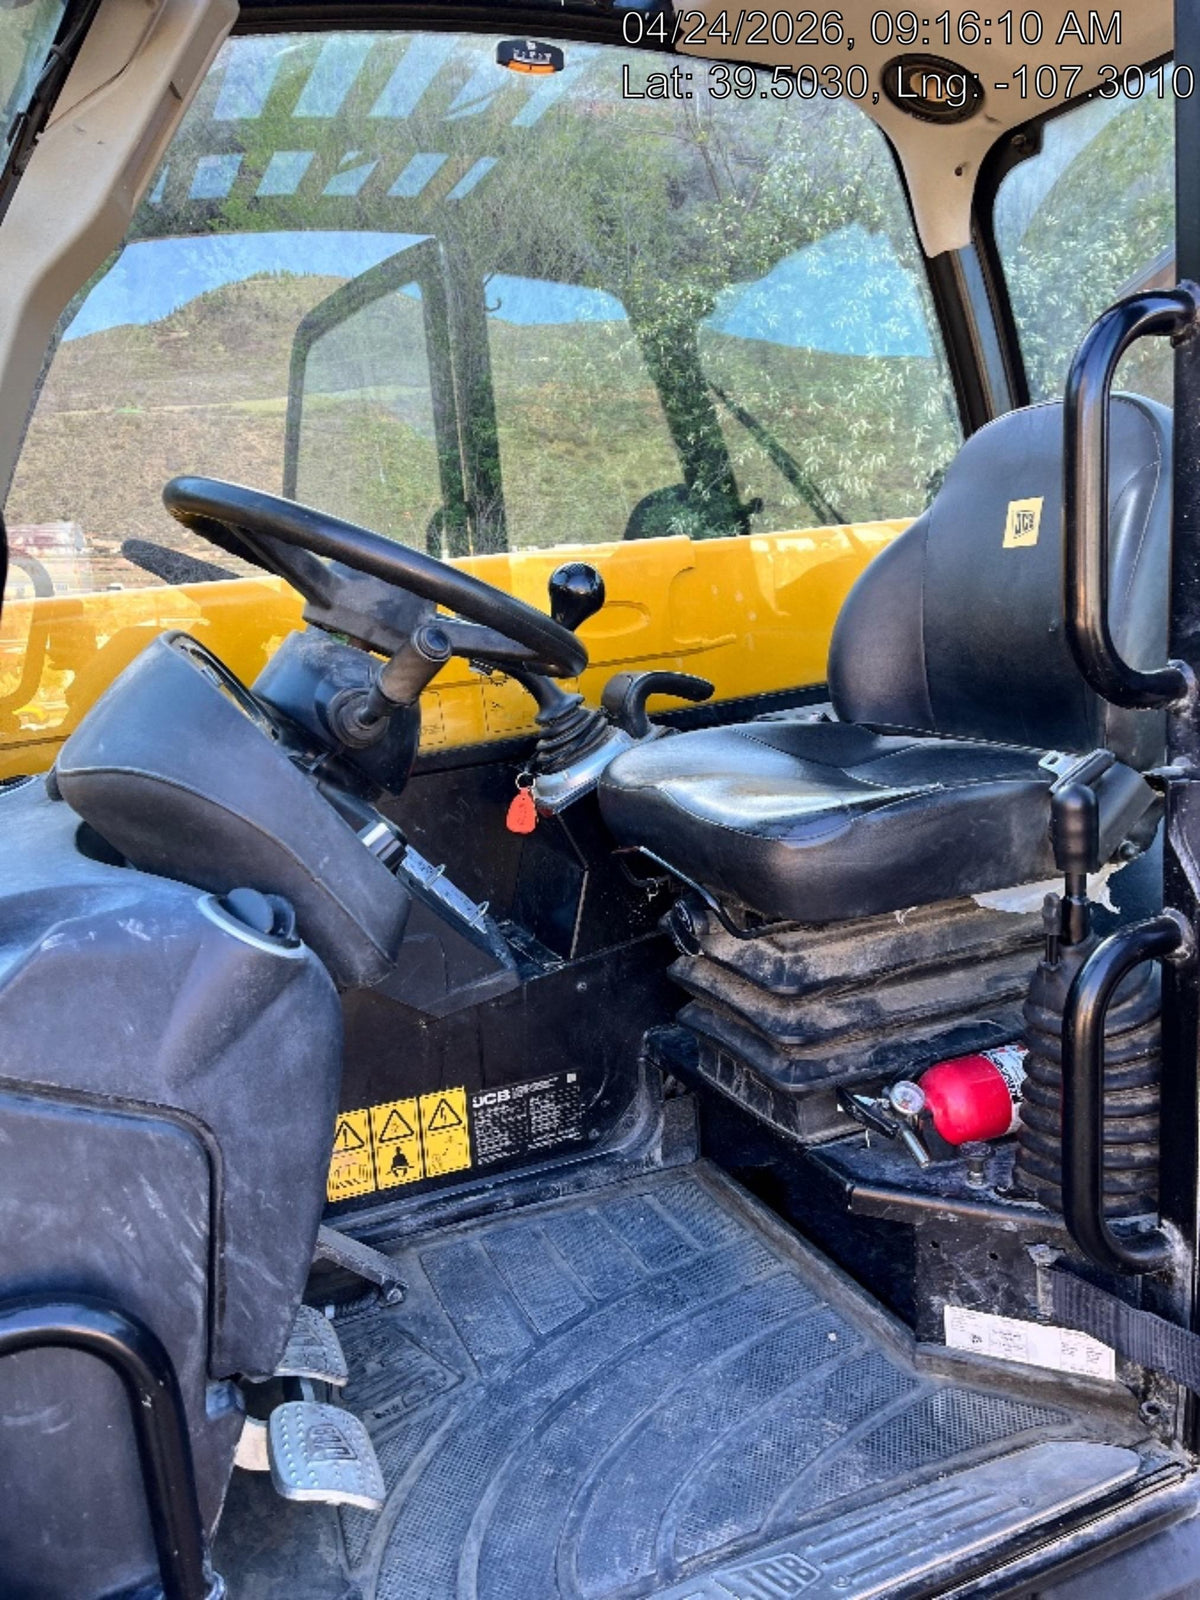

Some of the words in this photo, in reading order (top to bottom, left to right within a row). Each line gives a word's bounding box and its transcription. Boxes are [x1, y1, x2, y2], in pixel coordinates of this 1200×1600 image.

[1014, 512, 1034, 535] JCB
[472, 1089, 511, 1109] JCB
[727, 1557, 818, 1600] JCB
